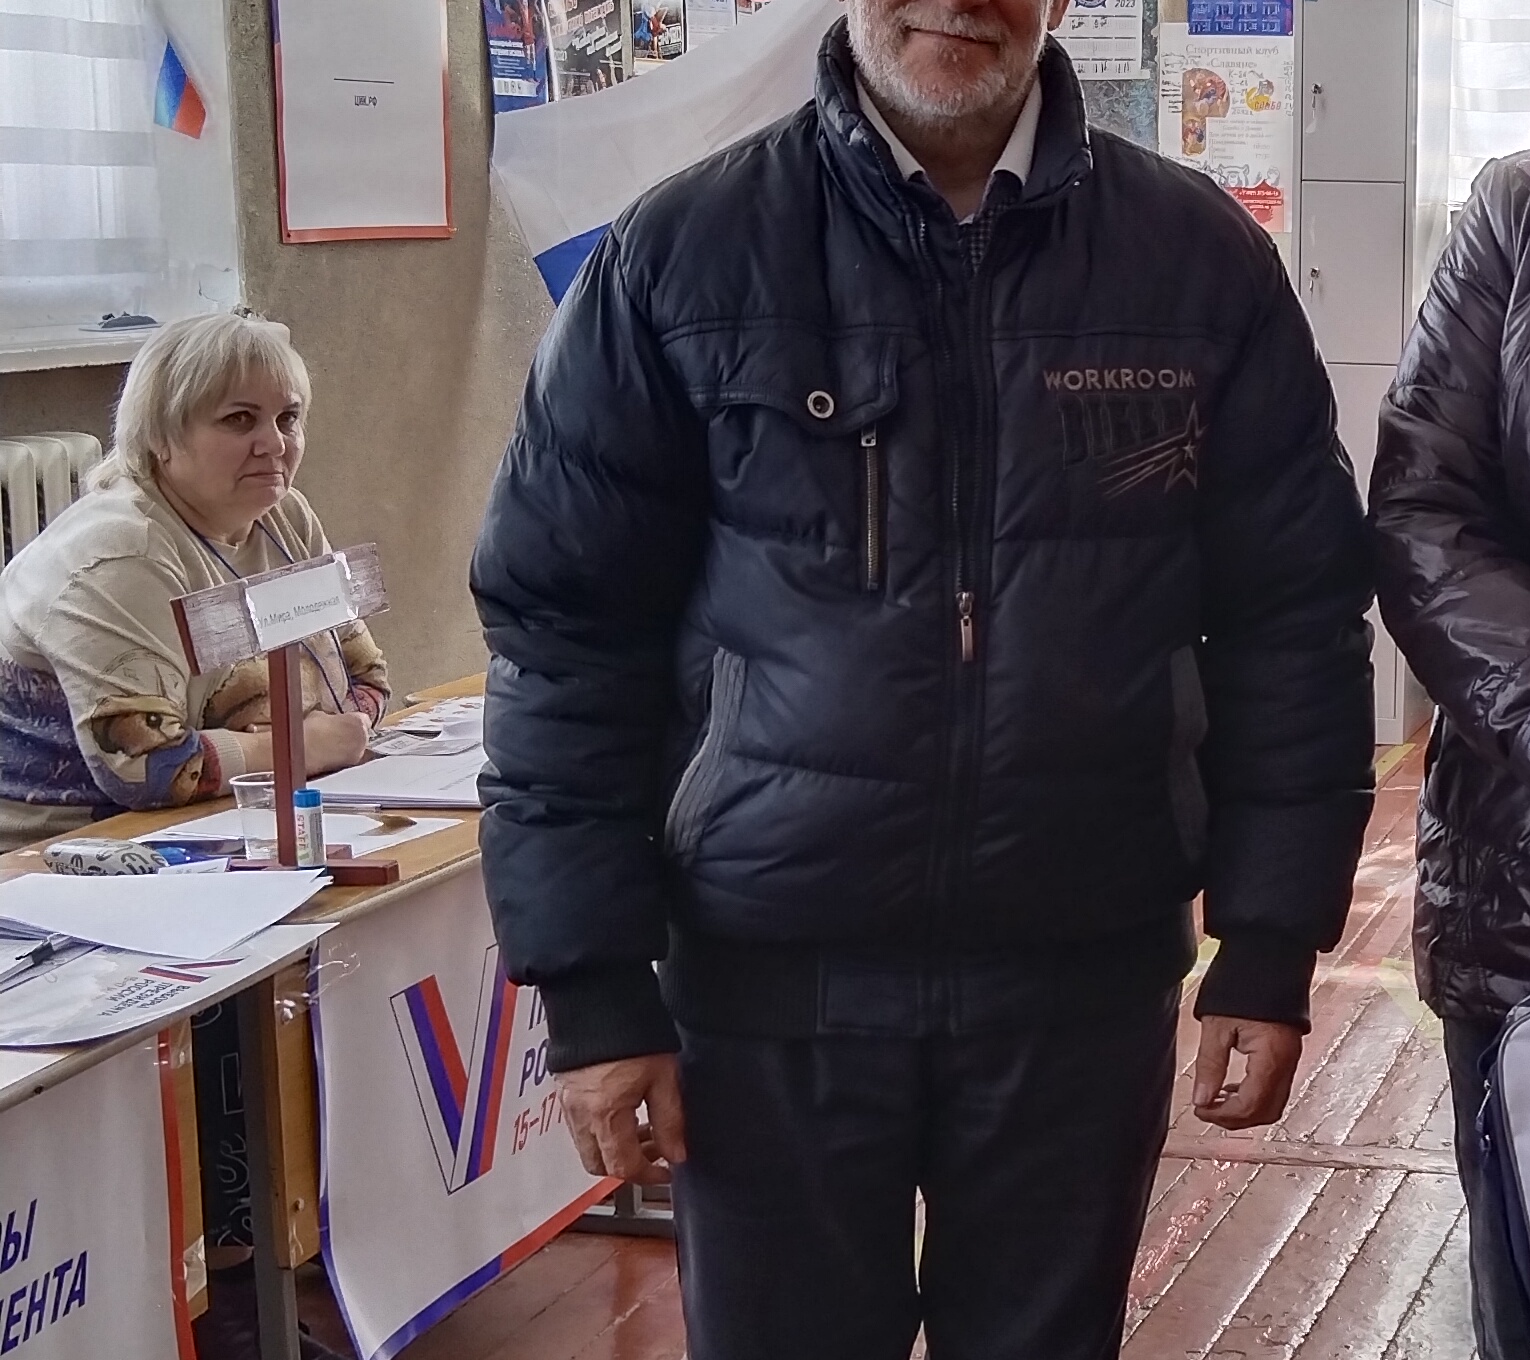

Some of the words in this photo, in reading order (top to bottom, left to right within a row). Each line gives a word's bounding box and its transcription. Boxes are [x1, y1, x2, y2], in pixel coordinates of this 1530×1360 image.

[1185, 43, 1253, 57] Спортивный
[1255, 45, 1279, 58] клуб
[1043, 368, 1196, 390] WORKROOM
[518, 1038, 551, 1098] РО
[0, 1198, 38, 1275] Ы
[0, 1250, 88, 1357] ЕНТА
